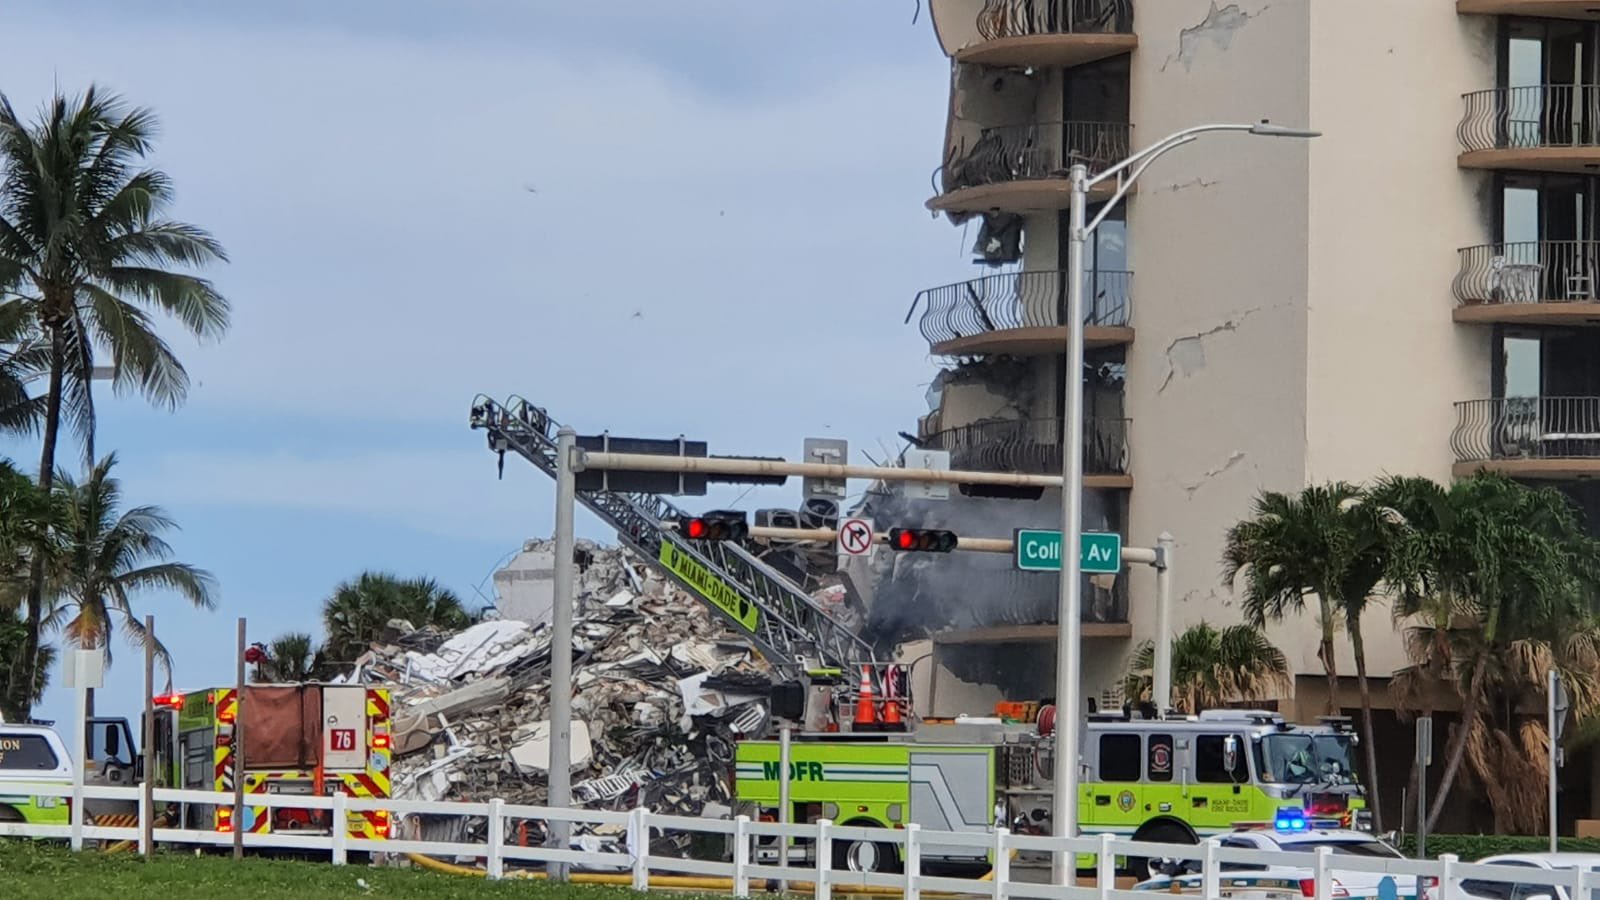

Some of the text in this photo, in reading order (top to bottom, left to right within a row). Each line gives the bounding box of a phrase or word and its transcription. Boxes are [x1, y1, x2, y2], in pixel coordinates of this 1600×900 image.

[1026, 540, 1112, 562] Coll Av
[680, 556, 737, 612] MIAMI-DADE
[335, 731, 352, 749] 76
[763, 761, 824, 781] MDFR
